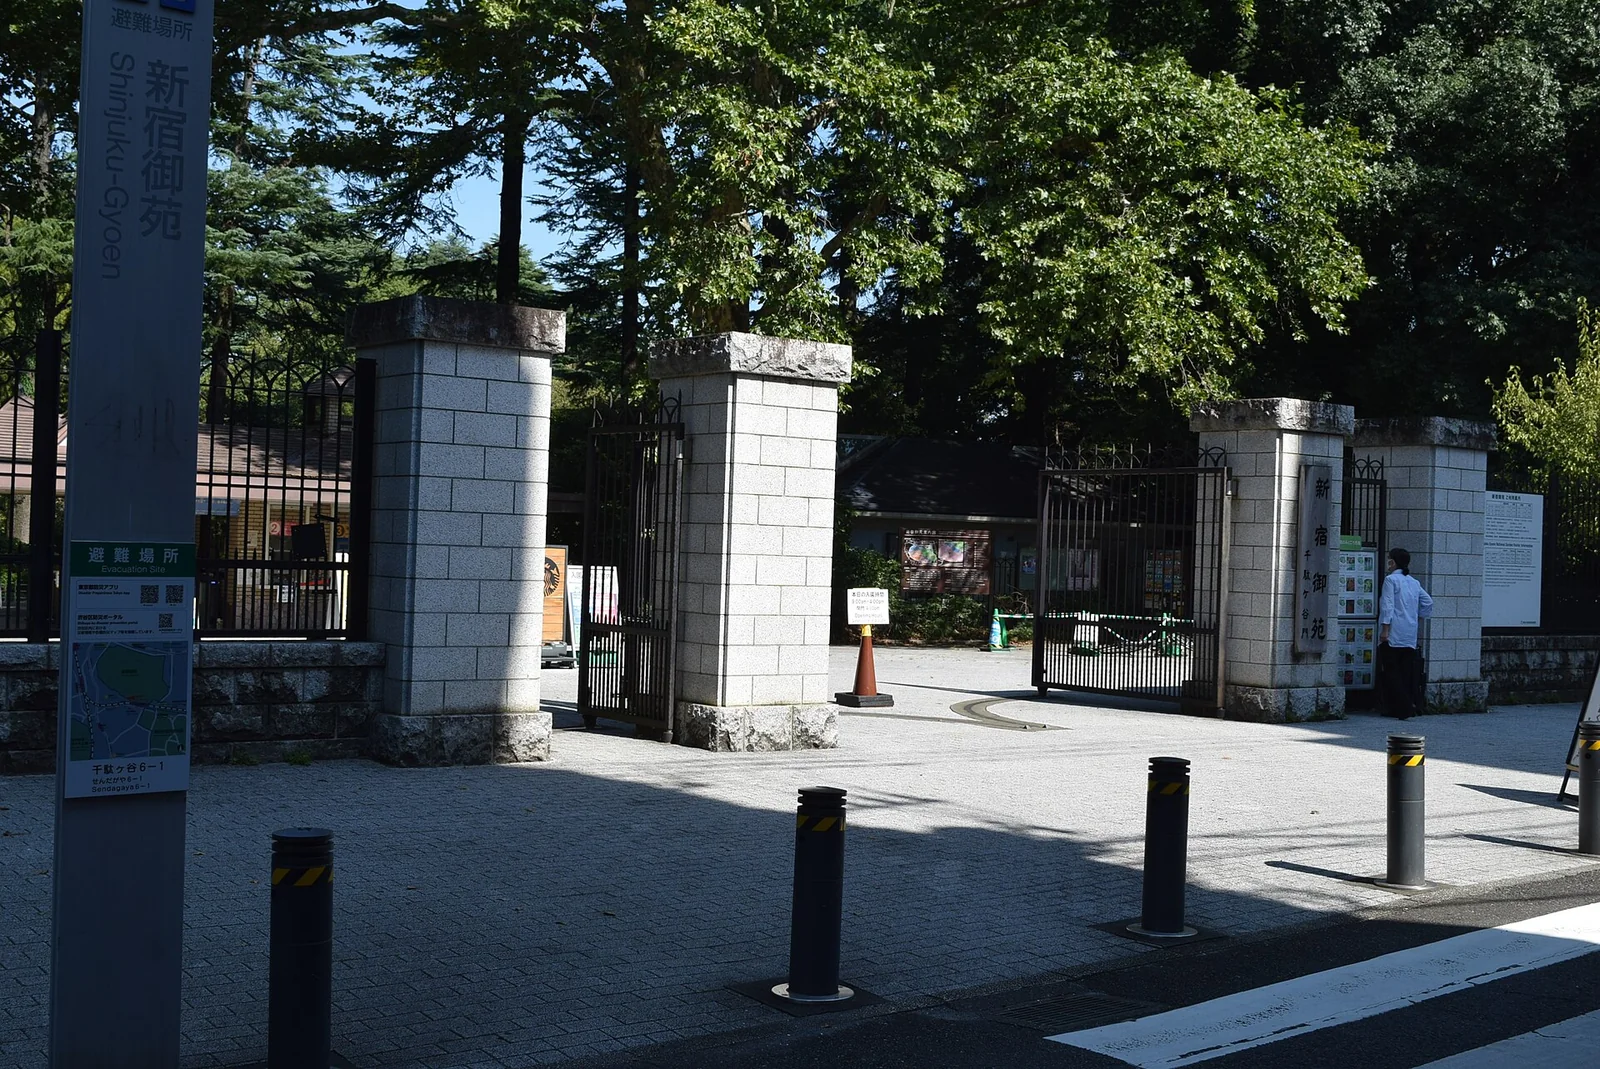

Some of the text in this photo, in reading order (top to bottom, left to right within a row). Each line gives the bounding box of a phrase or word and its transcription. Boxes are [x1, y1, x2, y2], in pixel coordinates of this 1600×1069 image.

[111, 7, 193, 42] 避難場所
[99, 51, 135, 280] Shinjuku-Gyoen
[138, 59, 190, 241] 新宿御苑
[88, 547, 179, 563] 避難場所
[101, 565, 166, 573] Evacuation Site
[1311, 477, 1330, 640] 新宿御苑
